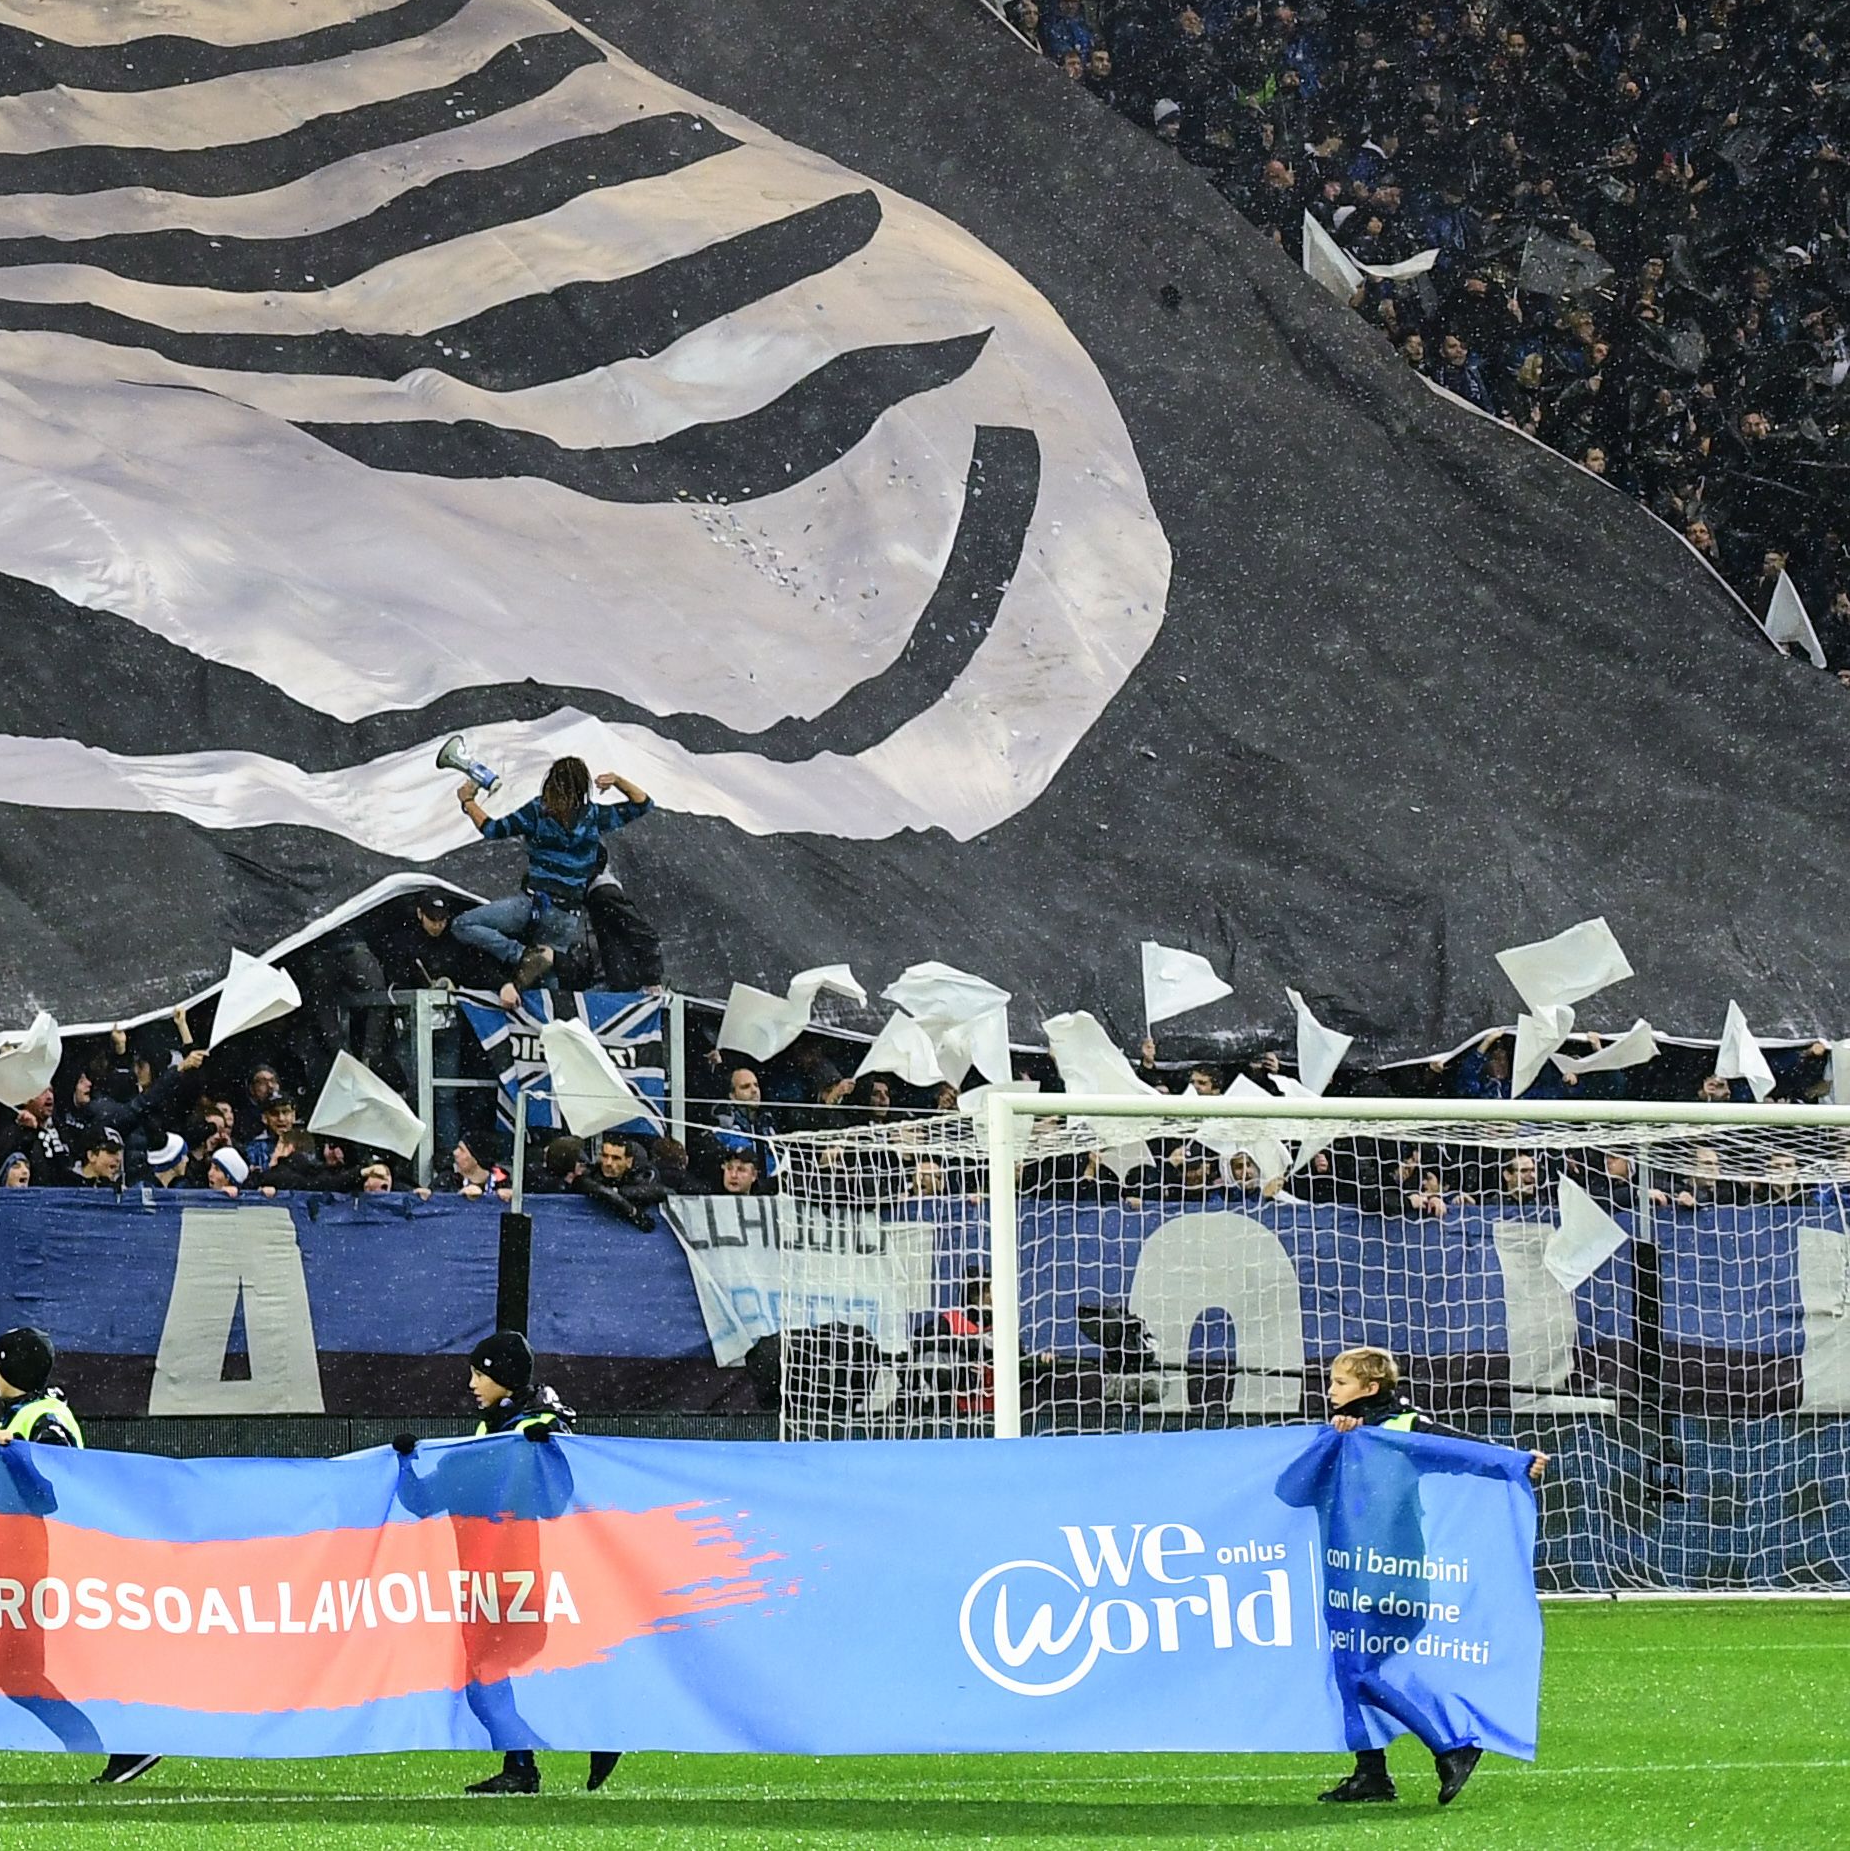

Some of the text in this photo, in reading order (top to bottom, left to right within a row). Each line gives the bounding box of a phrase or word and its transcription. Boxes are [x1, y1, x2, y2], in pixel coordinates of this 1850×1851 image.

[1216, 1541, 1287, 1565] onlus
[1326, 1546, 1469, 1583] con i bambini
[1328, 1586, 1461, 1624] con le donne
[1360, 1629, 1410, 1655] loro
[1415, 1633, 1490, 1666] diritti
